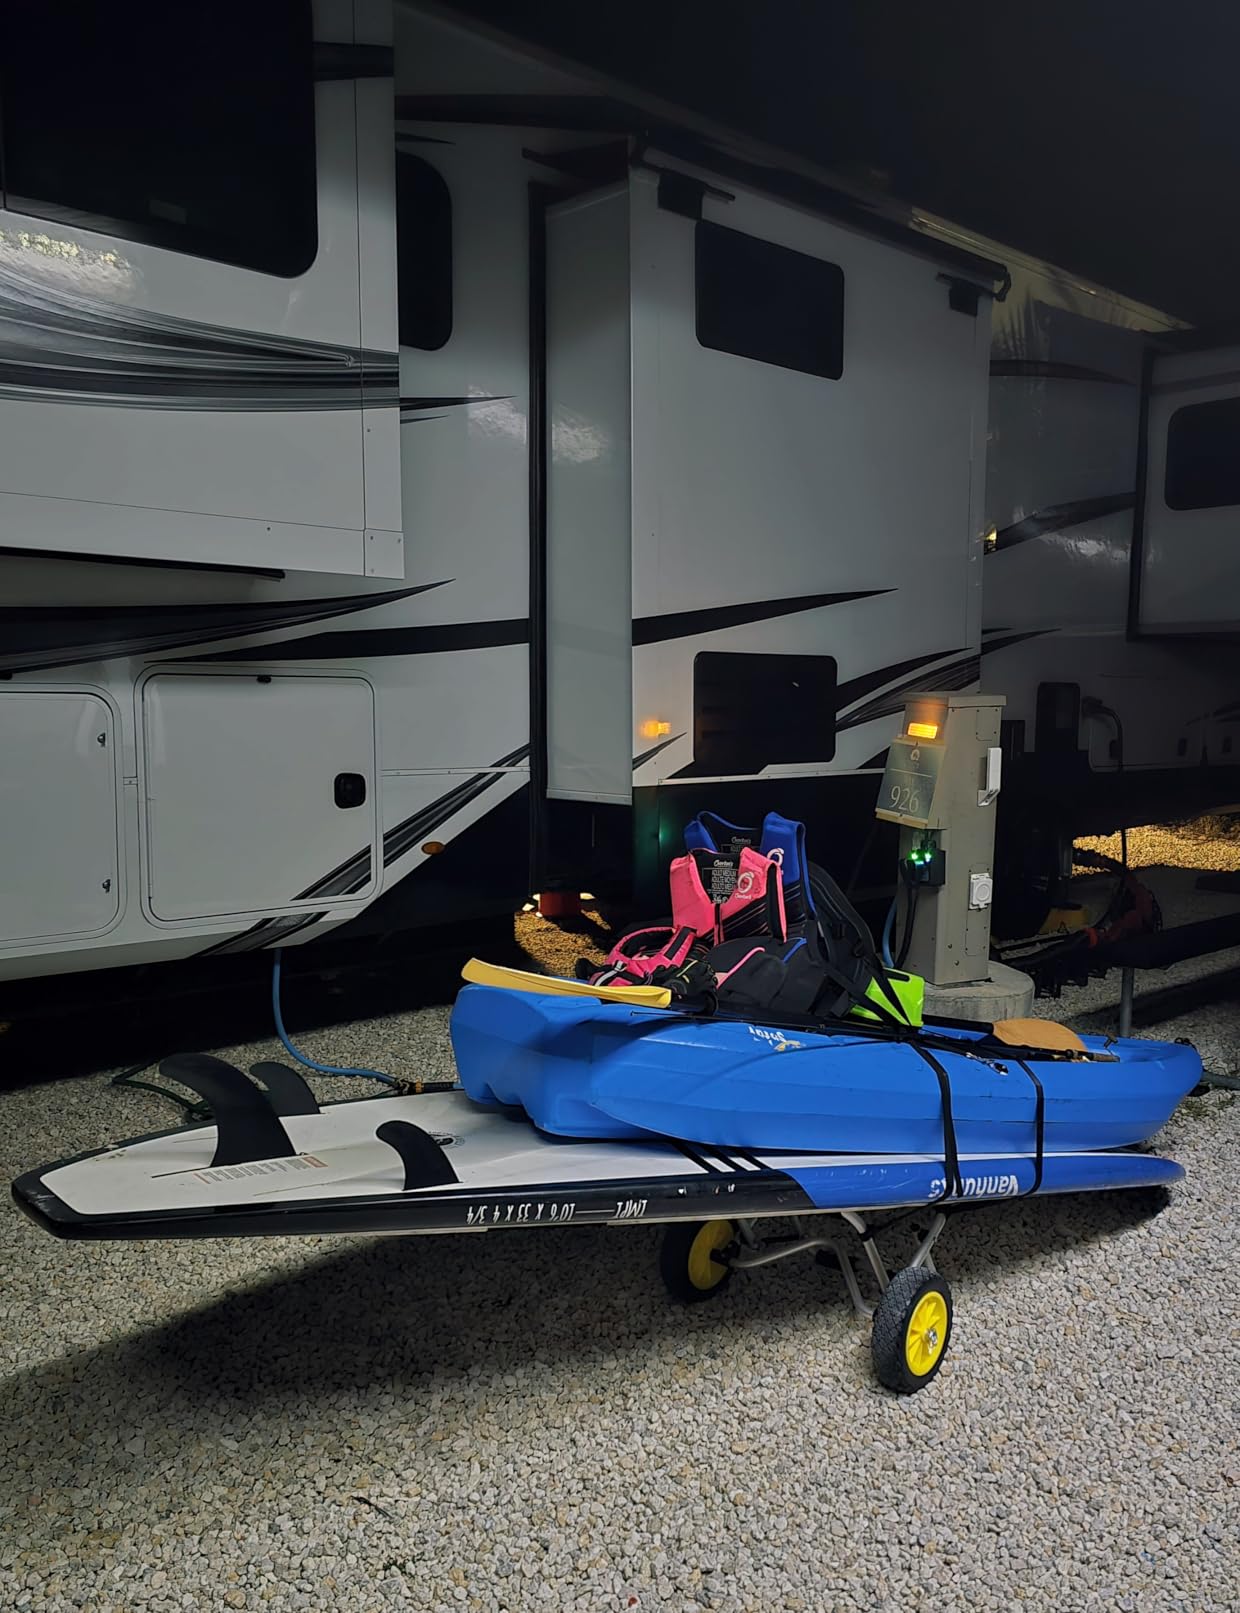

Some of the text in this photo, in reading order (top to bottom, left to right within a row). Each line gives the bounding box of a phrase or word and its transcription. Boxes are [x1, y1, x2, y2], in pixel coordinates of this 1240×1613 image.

[890, 785, 920, 813] 926
[467, 1206, 488, 1225] 3/4
[493, 1205, 500, 1224] 4
[516, 1203, 531, 1223] 33
